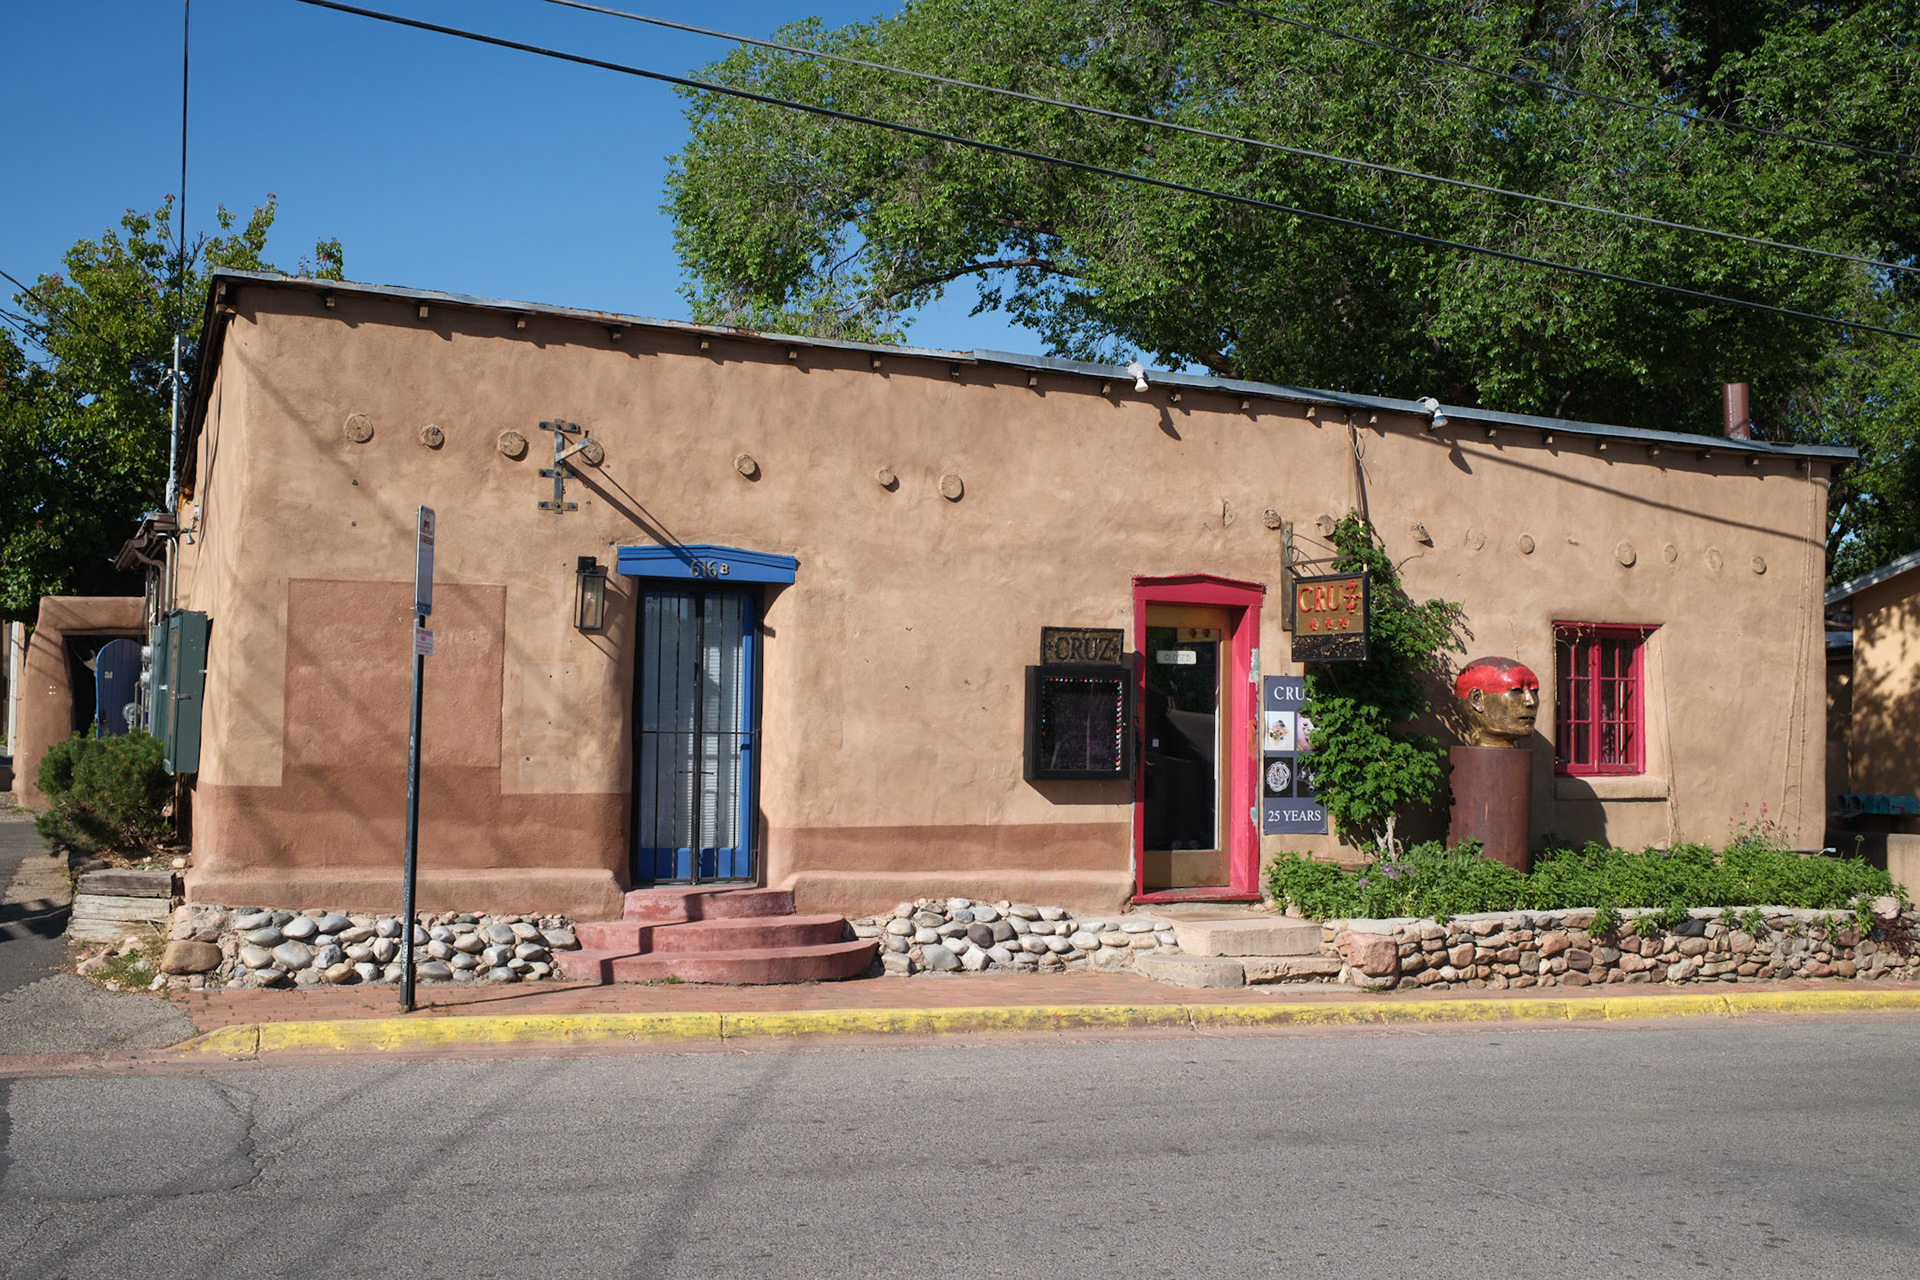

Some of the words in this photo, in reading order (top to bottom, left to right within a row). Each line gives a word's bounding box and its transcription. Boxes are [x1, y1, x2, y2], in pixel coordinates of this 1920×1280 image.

[1298, 580, 1362, 614] CRUZ
[1055, 637, 1112, 660] CRUZ
[1164, 653, 1191, 662] CLOSED
[1274, 686, 1312, 702] CRU
[1268, 810, 1280, 822] 25
[1283, 810, 1321, 822] YEARS
